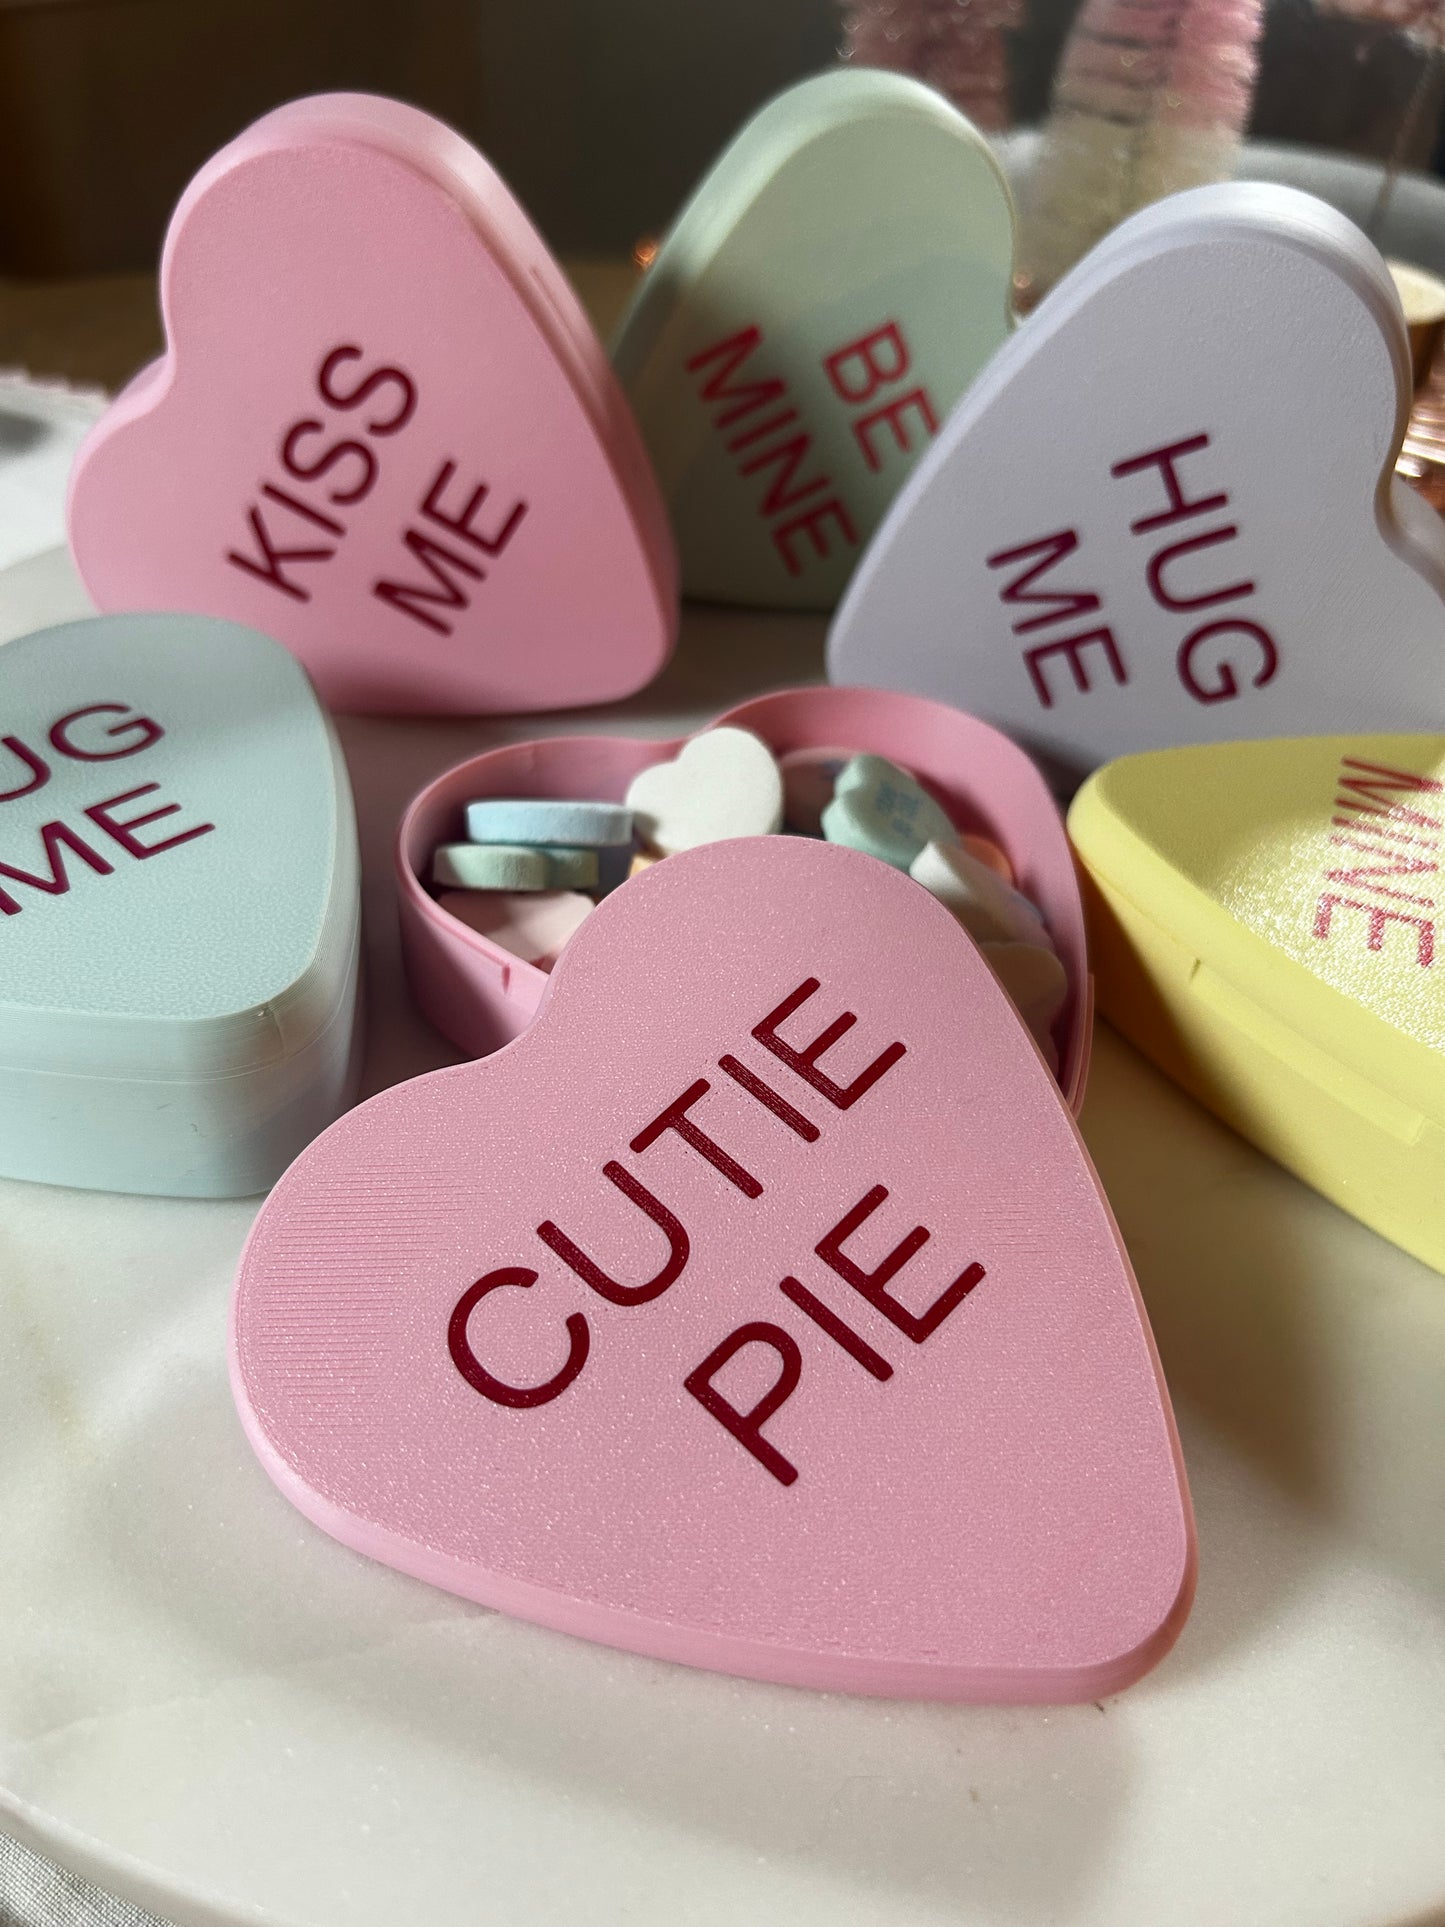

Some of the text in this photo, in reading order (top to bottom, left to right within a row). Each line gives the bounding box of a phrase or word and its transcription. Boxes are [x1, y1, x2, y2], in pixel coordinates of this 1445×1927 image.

[226, 343, 419, 603] KISS
[685, 323, 859, 577] MINE
[823, 318, 942, 474] BE
[372, 459, 528, 636] ME
[986, 528, 1129, 709] ME
[1110, 433, 1278, 705] HUG
[0, 782, 215, 916] ME
[448, 977, 907, 1408] CUTIE
[684, 1184, 986, 1486] PIE
